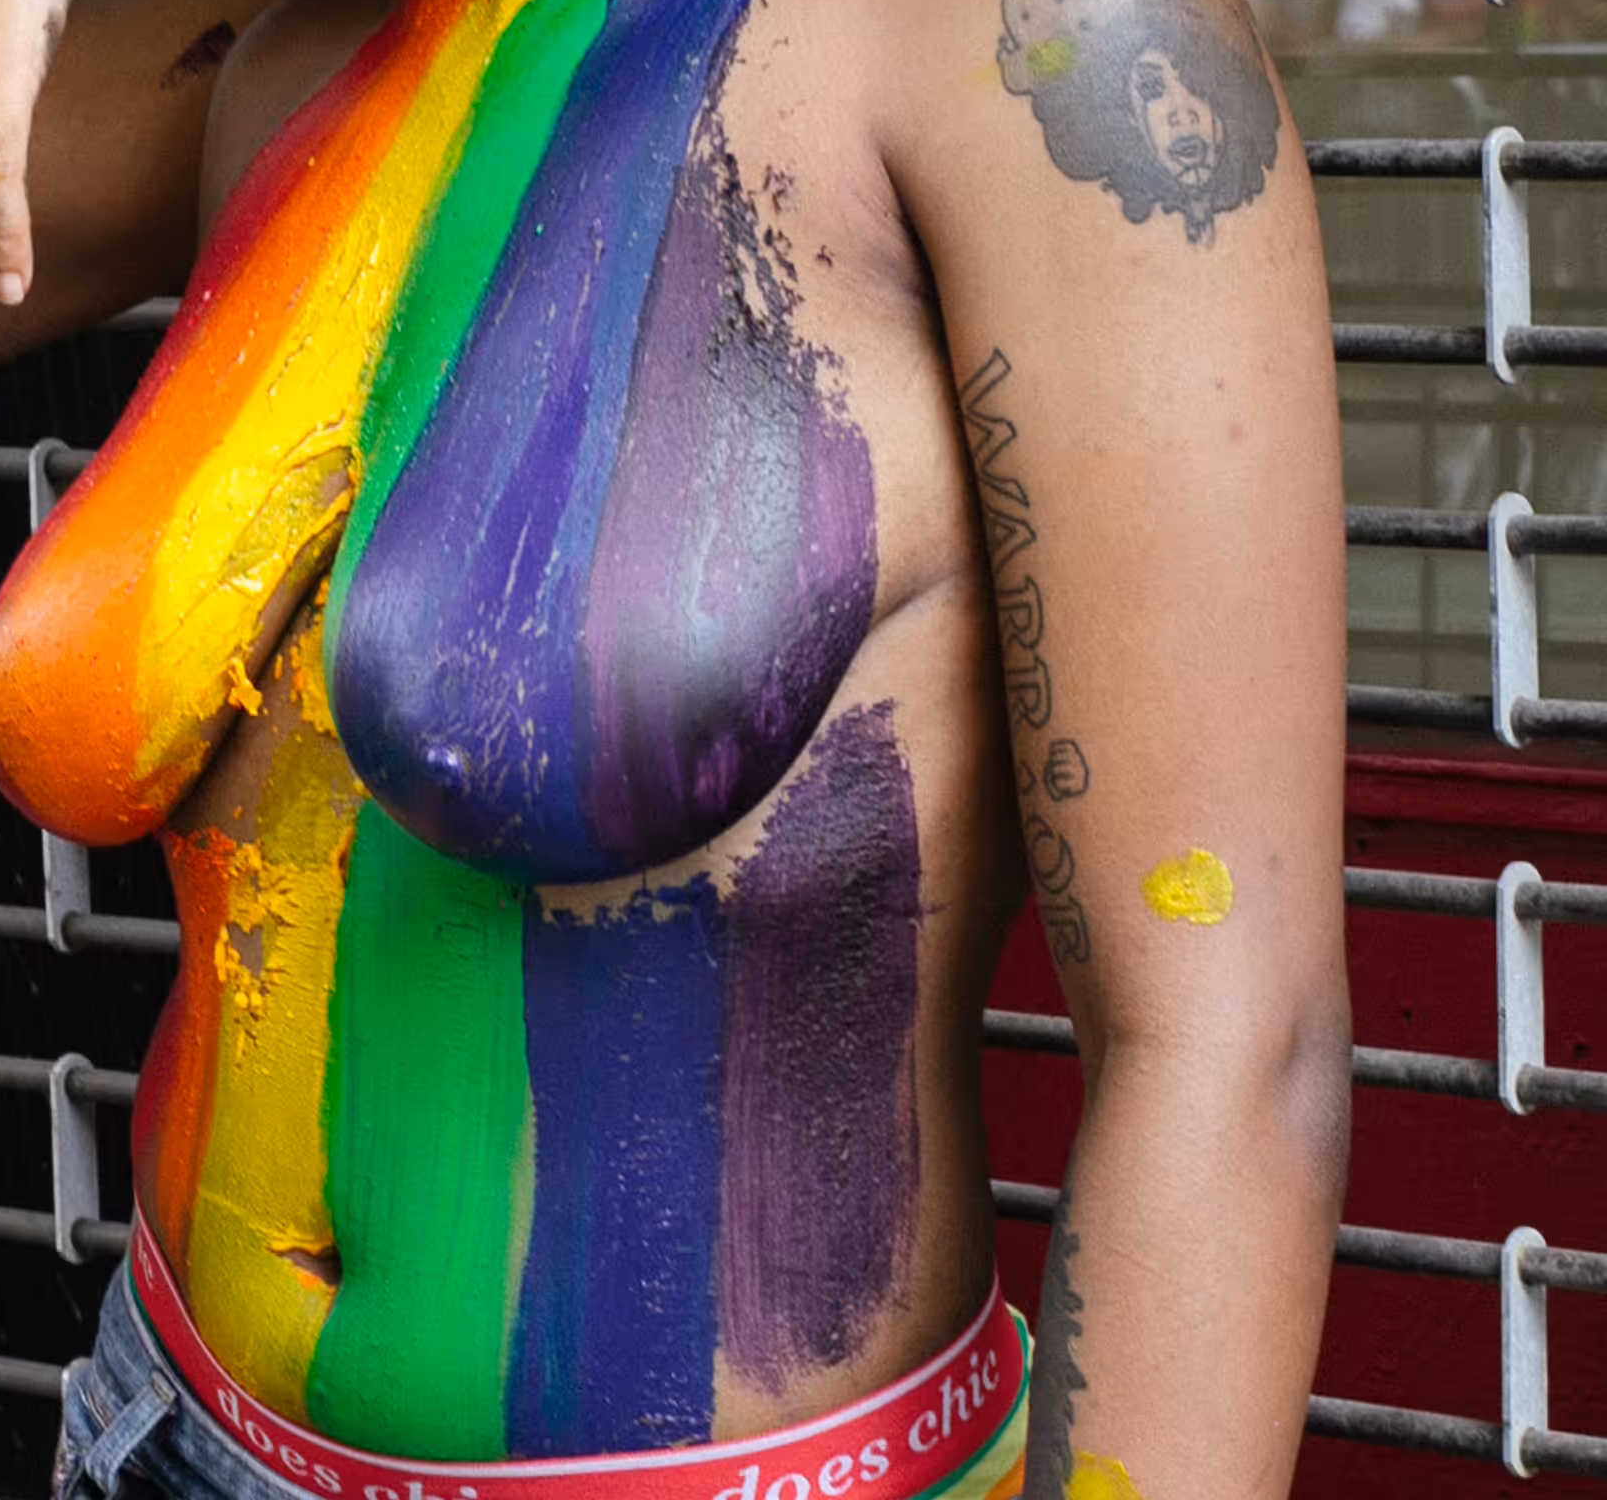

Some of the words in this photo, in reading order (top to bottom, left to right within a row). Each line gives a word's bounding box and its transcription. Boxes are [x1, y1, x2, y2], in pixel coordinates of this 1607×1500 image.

[960, 347, 1091, 972] WARROR
[217, 1388, 342, 1494] does
[908, 1349, 1000, 1453] chic
